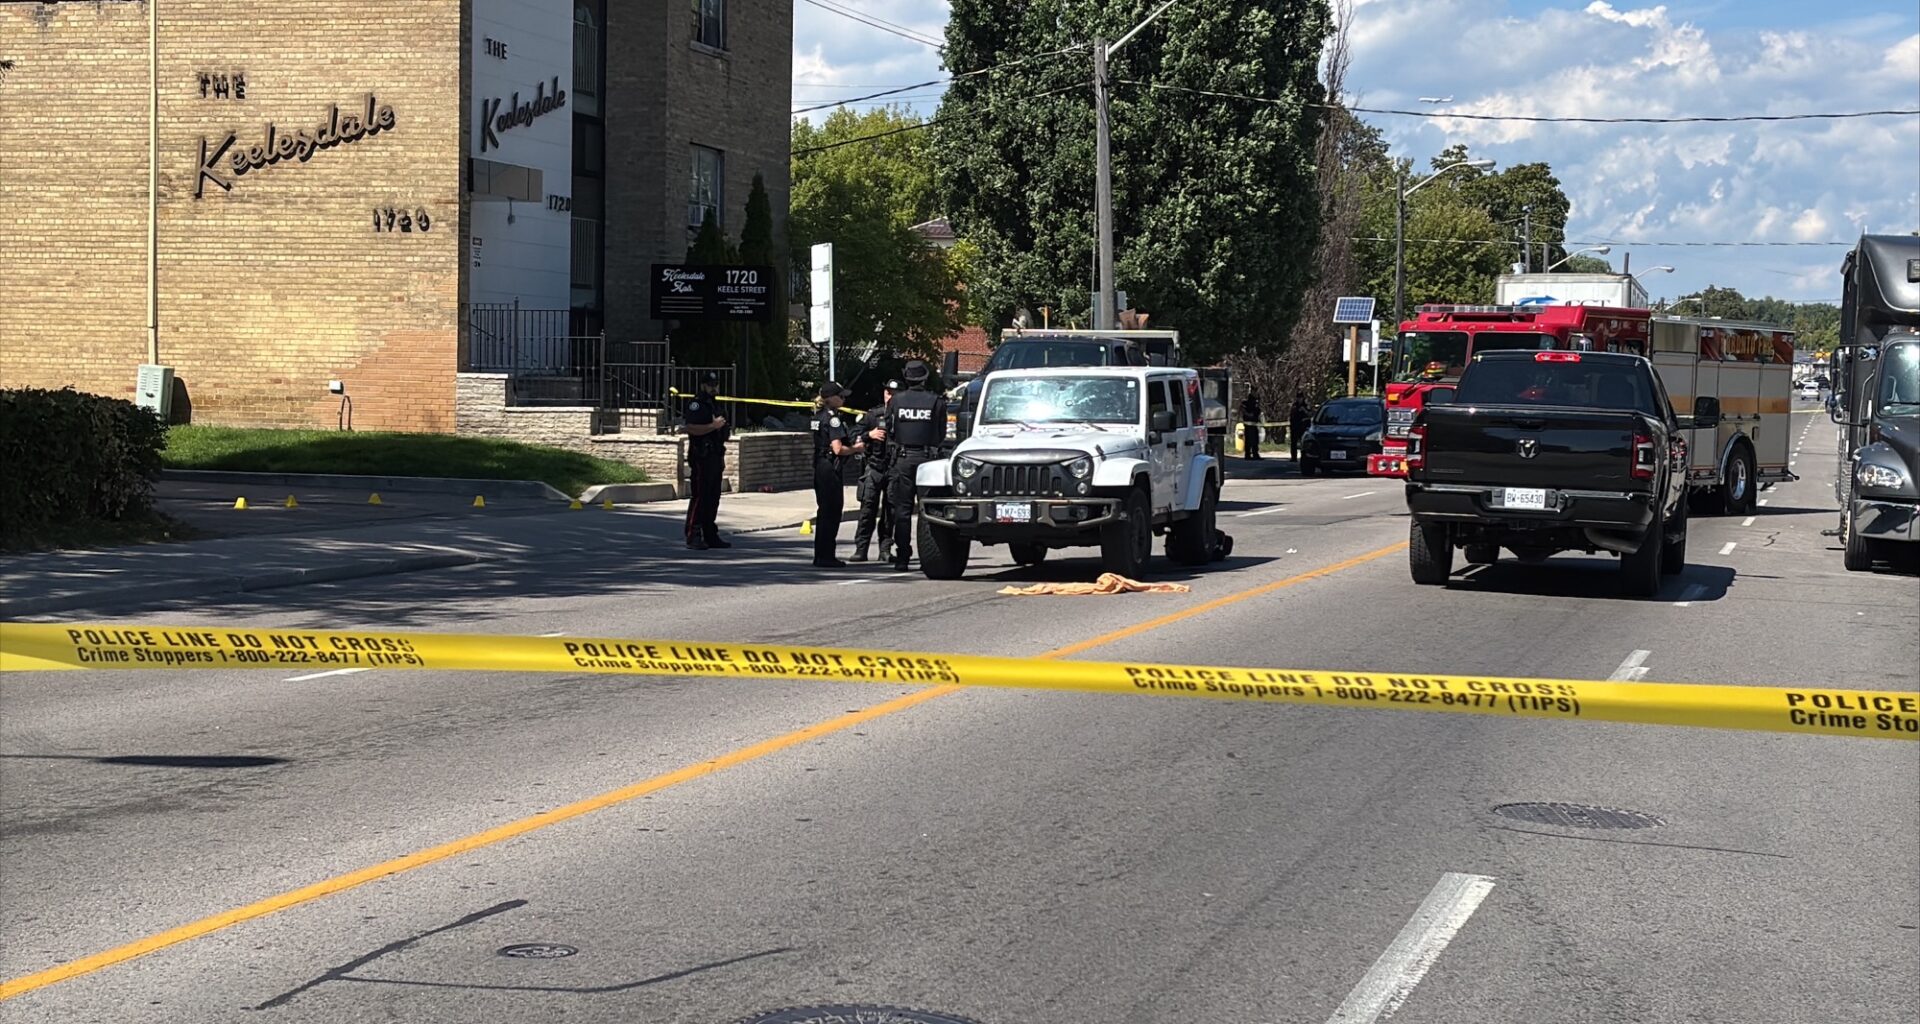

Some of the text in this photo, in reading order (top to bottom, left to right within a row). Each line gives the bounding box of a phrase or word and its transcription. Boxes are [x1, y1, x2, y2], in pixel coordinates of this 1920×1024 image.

[485, 38, 508, 60] THE
[198, 72, 246, 99] THE
[480, 76, 567, 152] Keelesdale
[193, 91, 397, 200] Keelesdale
[717, 285, 767, 294] KEELE STREET
[725, 270, 758, 285] 1720
[898, 408, 932, 420] POLICE
[67, 629, 415, 653] POLICE LINE DO NOT CROSS
[77, 646, 425, 667] Crime Stoppers 1-800-222-8477 (TIPS)
[563, 641, 952, 671] POLICE LINE DO NOT CROSS
[574, 656, 960, 684] Crime Stoppers 1-800-222-8477 (TIPS)
[1124, 666, 1577, 697] POLICE LINE DO NOT CROSS
[1132, 676, 1581, 716] Crime Stoppers 1-800-222-8477 (TIPS)
[1786, 693, 1918, 713] POLICE
[1789, 708, 1919, 733] Crime Sto
